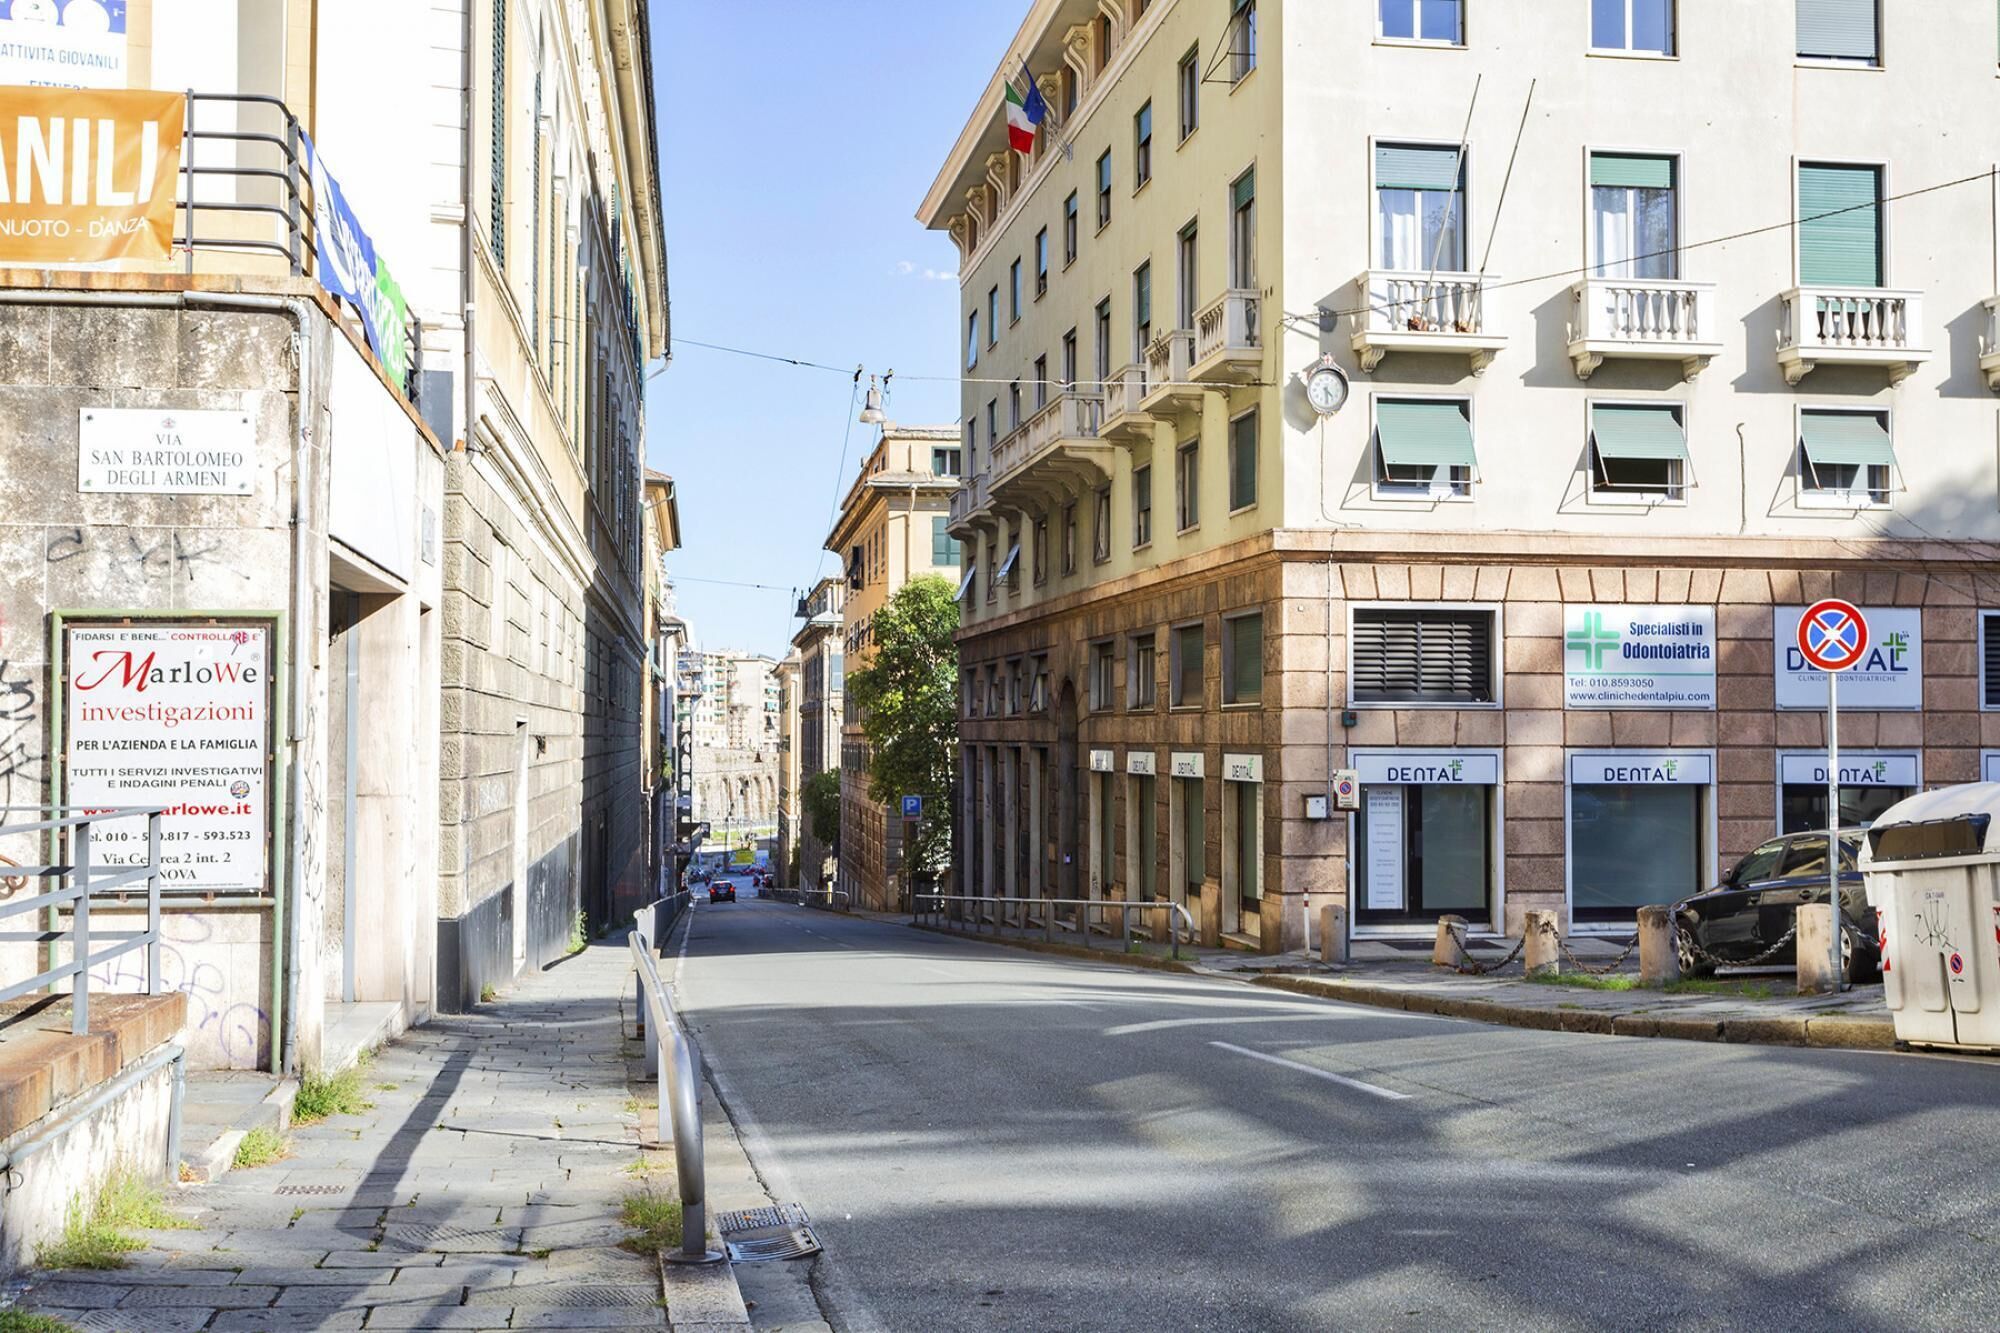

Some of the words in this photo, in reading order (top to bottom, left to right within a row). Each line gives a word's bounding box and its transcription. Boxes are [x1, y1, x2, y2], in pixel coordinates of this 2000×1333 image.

[59, 50, 119, 70] GIOVANILI
[0, 115, 159, 206] NILI
[156, 433, 182, 446] VIA
[91, 449, 123, 465] SAN
[132, 450, 243, 467] BARTOLOMEO
[107, 469, 155, 486] DEGLI
[164, 470, 226, 487] ARMENI
[1629, 621, 1689, 637] Specialisti
[1692, 623, 1703, 636] in
[75, 633, 115, 641] FIDARSI
[171, 631, 249, 644] CONTROLLARE
[1622, 641, 1711, 660] Odontoiatria
[74, 650, 257, 693] MarloWe
[1798, 675, 1828, 683] CLINICH
[1569, 690, 1711, 703] www.clinichedentalpiu.com
[80, 701, 255, 728] investigazioni
[76, 740, 99, 751] PER
[102, 740, 167, 751] L'AZIENDA
[170, 740, 178, 750] E
[181, 740, 197, 750] LA
[200, 739, 258, 750] FAMIGLIA
[72, 768, 108, 777] TUTTI
[111, 768, 115, 776] I
[118, 768, 168, 776] SERVIZI
[171, 767, 262, 776] INVESTIGATIVI
[1388, 767, 1463, 782] DENTAL
[1604, 767, 1678, 782] DENTAL
[1814, 767, 1886, 783] DNTAL
[108, 780, 116, 788] E
[119, 779, 177, 788] INDAGINI
[180, 779, 227, 788] PENALI
[905, 798, 918, 811] P
[106, 833, 128, 842] 010
[204, 831, 251, 841] 593.523
[102, 853, 125, 865] Via
[183, 853, 192, 863] 2
[196, 852, 218, 863] int.
[223, 852, 232, 863] 2
